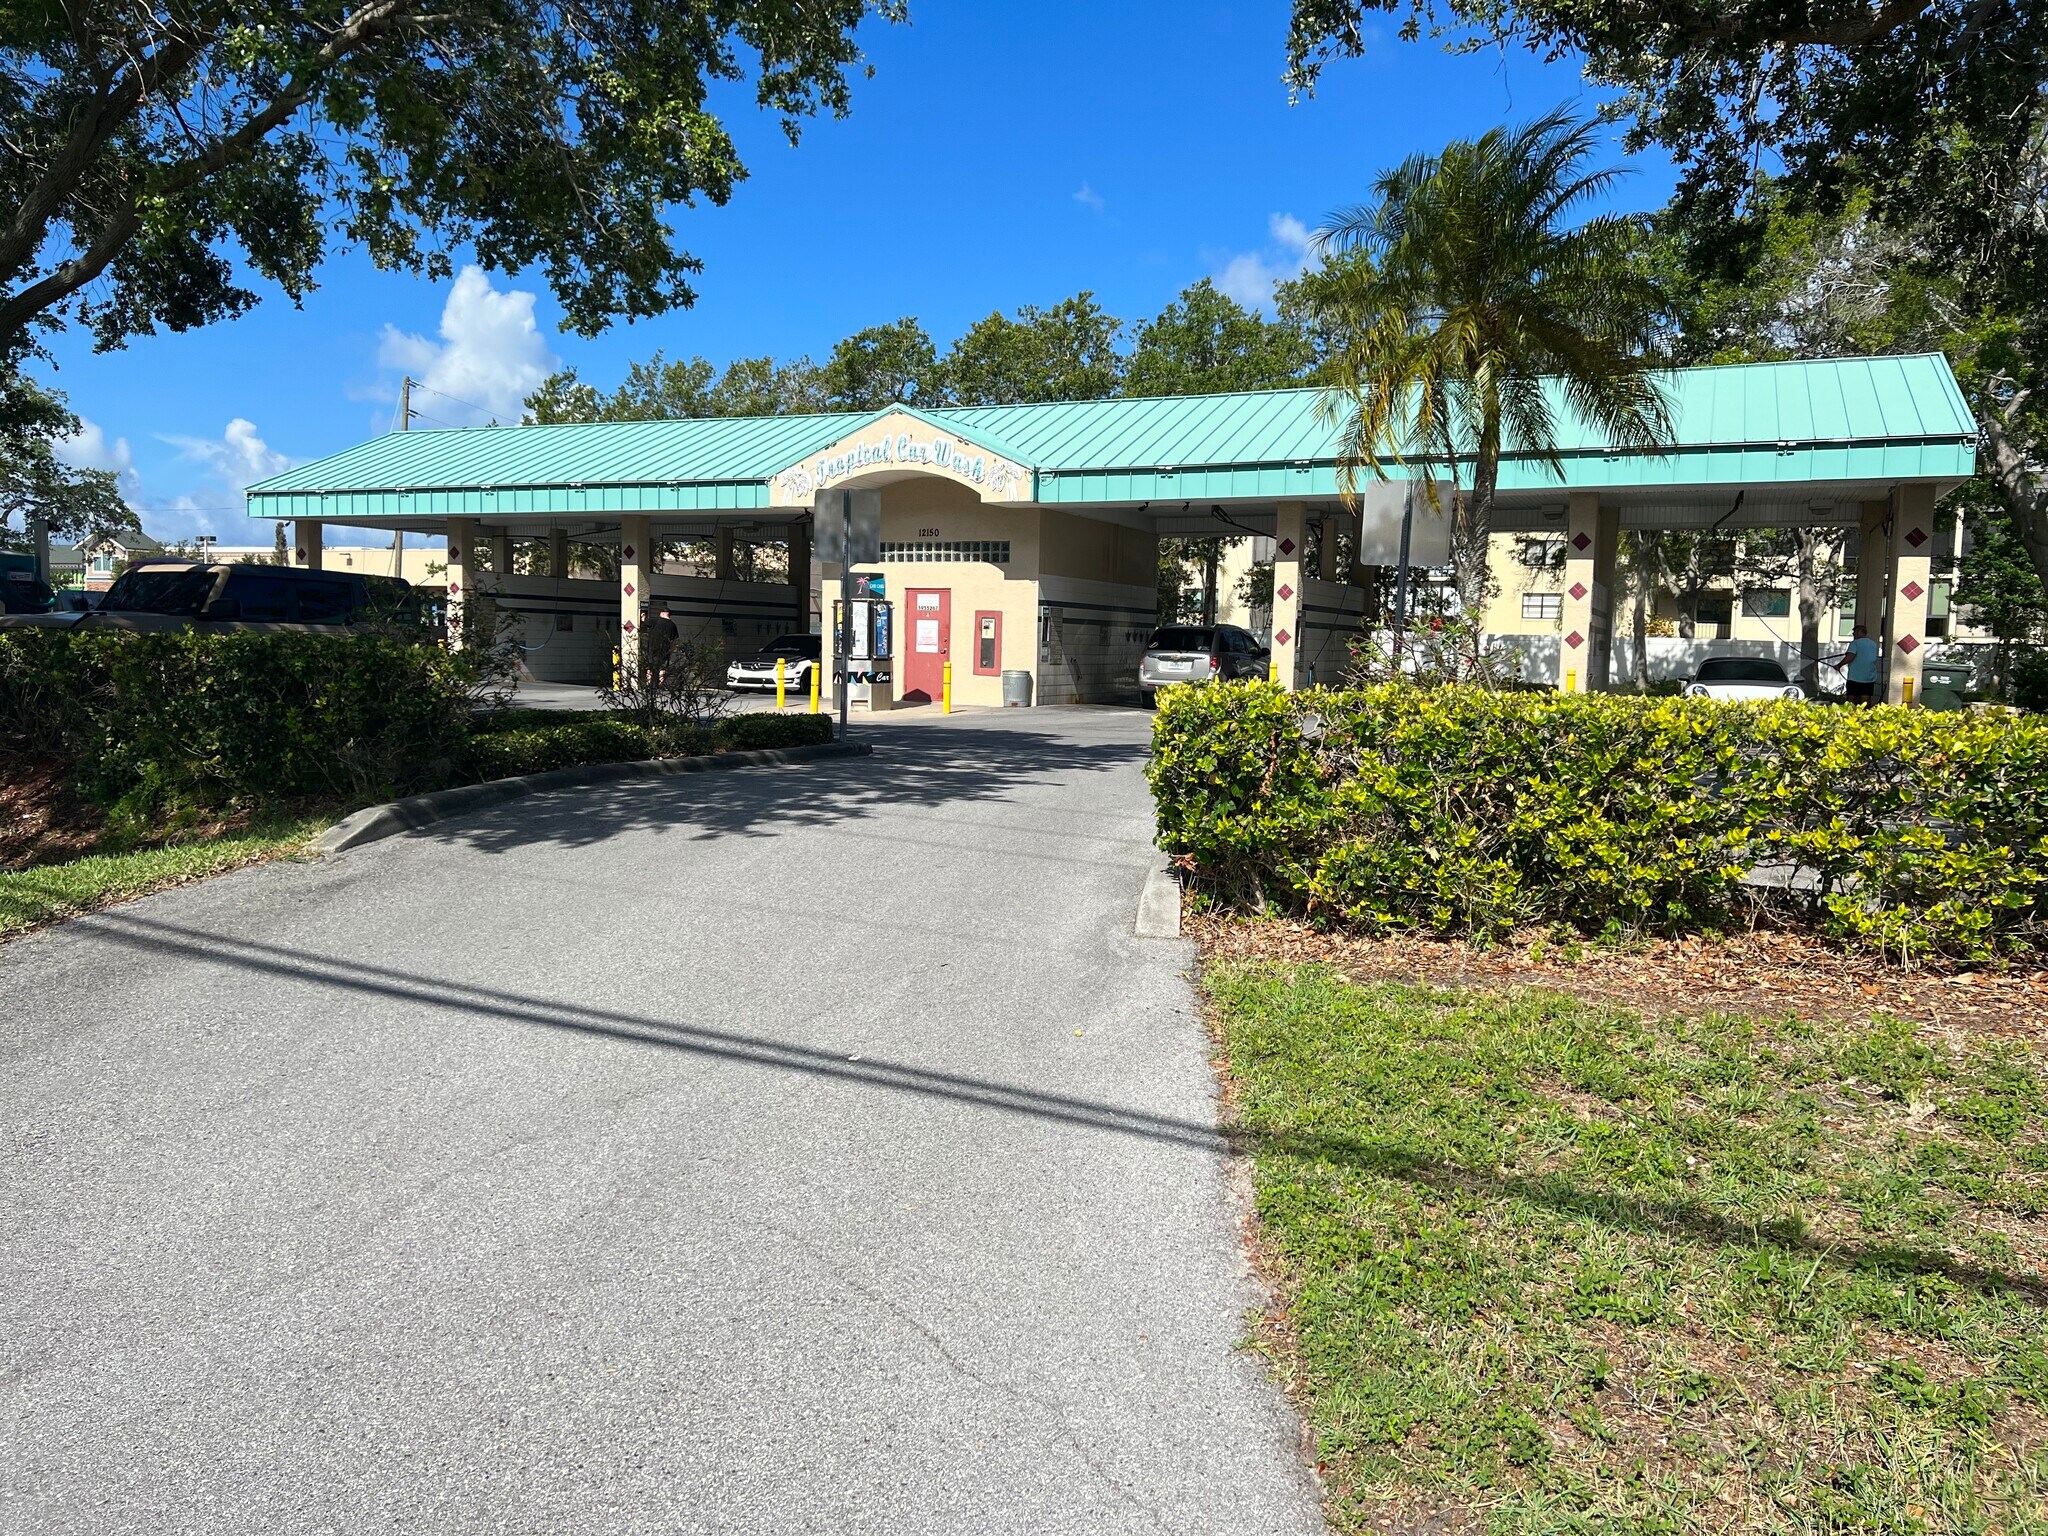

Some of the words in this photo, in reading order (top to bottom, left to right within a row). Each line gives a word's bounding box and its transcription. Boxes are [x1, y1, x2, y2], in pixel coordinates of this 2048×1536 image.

[816, 435, 893, 486] Tropical
[897, 434, 931, 465] Car
[933, 437, 985, 483] Wash
[918, 528, 940, 537] 12150
[876, 671, 890, 683] Car
